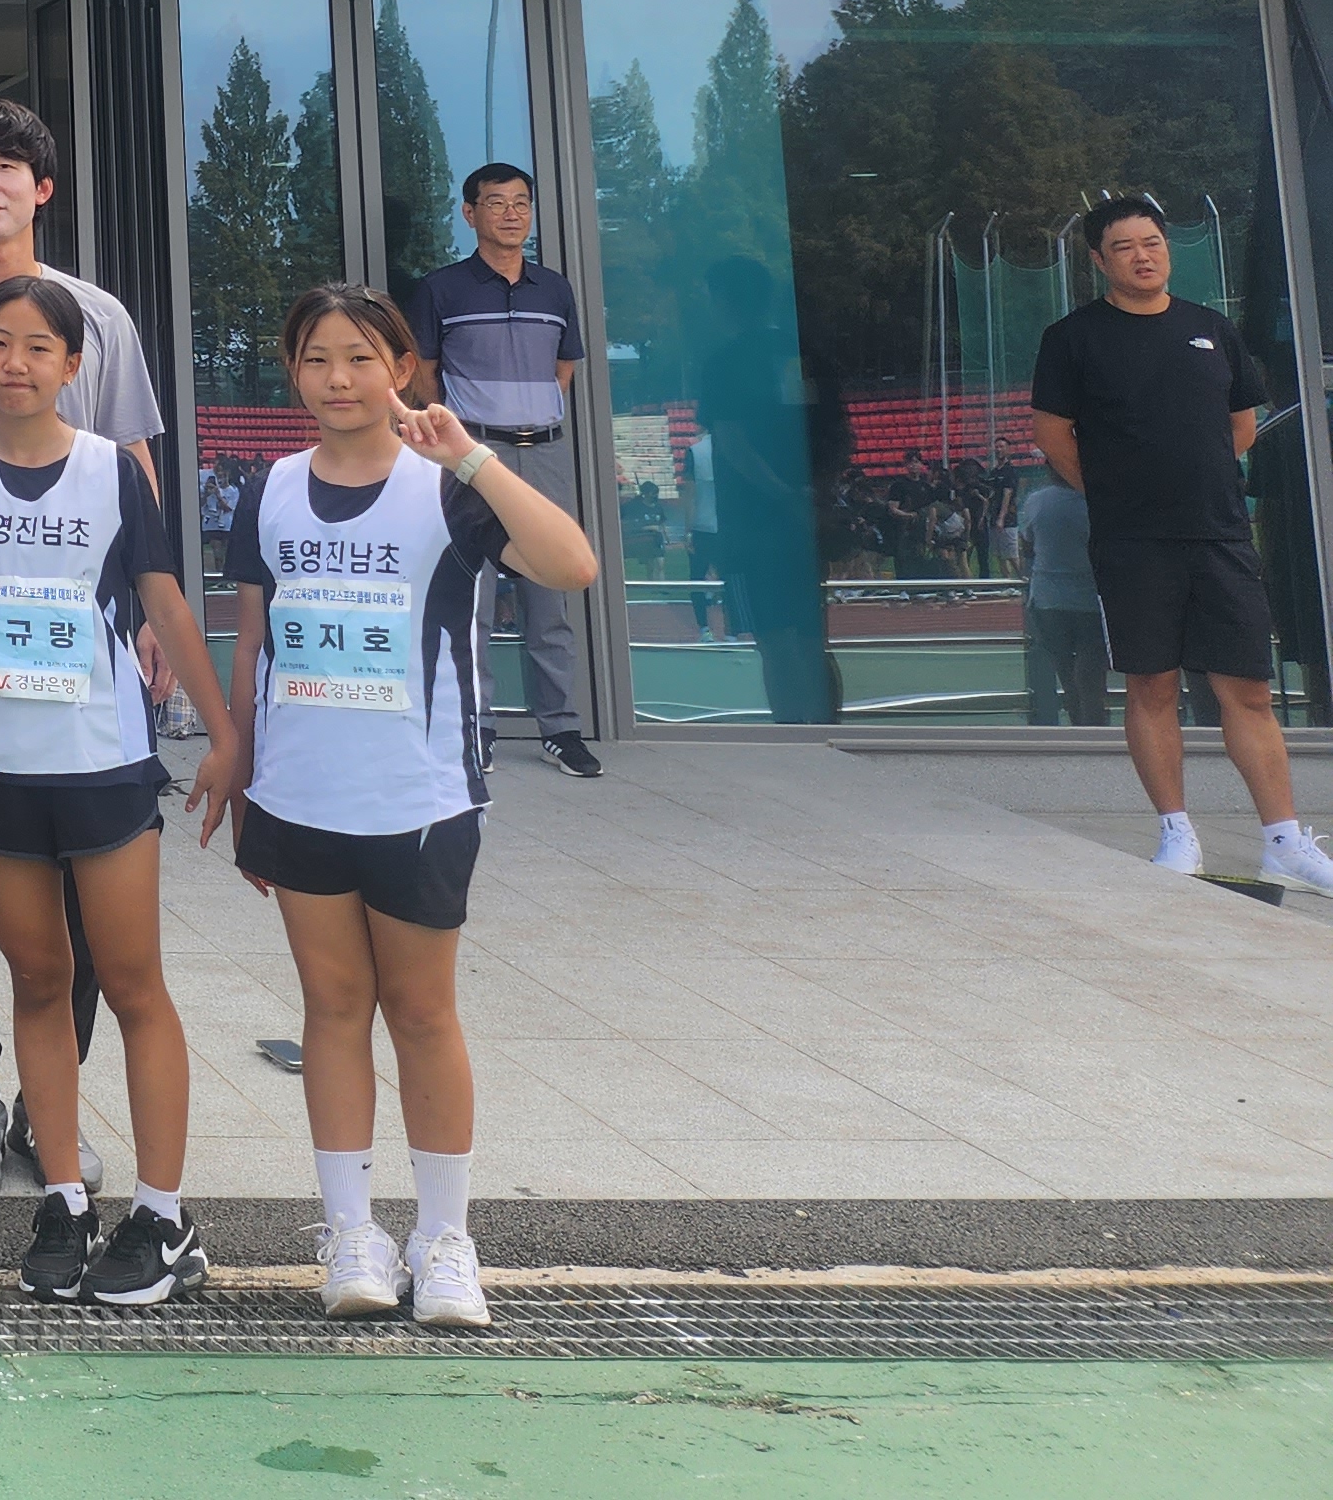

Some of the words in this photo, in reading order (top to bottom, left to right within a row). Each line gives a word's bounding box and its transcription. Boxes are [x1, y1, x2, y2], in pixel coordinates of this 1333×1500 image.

[278, 539, 400, 575] 통영진남초
[15, 674, 76, 695] 경남은행
[287, 680, 329, 699] BNK
[330, 682, 394, 702] 경남은행
